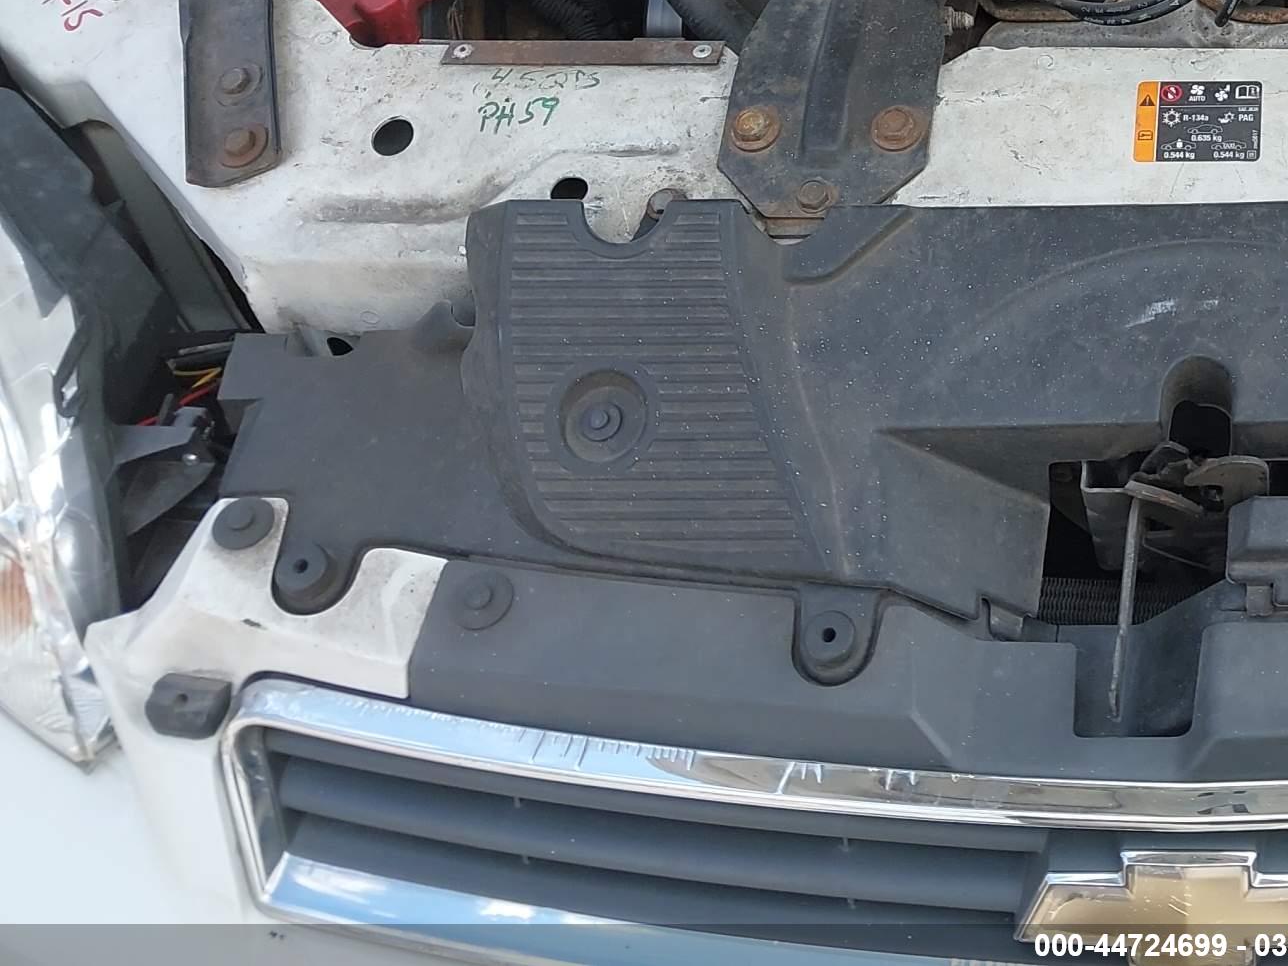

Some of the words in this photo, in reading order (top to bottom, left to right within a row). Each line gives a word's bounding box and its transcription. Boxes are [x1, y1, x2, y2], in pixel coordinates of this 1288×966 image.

[1182, 114, 1209, 122] R-134a
[1238, 114, 1254, 122] PAG
[1191, 134, 1211, 142] 0.635
[1213, 134, 1222, 143] kg
[1163, 151, 1184, 159] 0.544
[1185, 151, 1195, 160] kg
[1213, 151, 1234, 159] 0.544
[1235, 151, 1245, 160] kg
